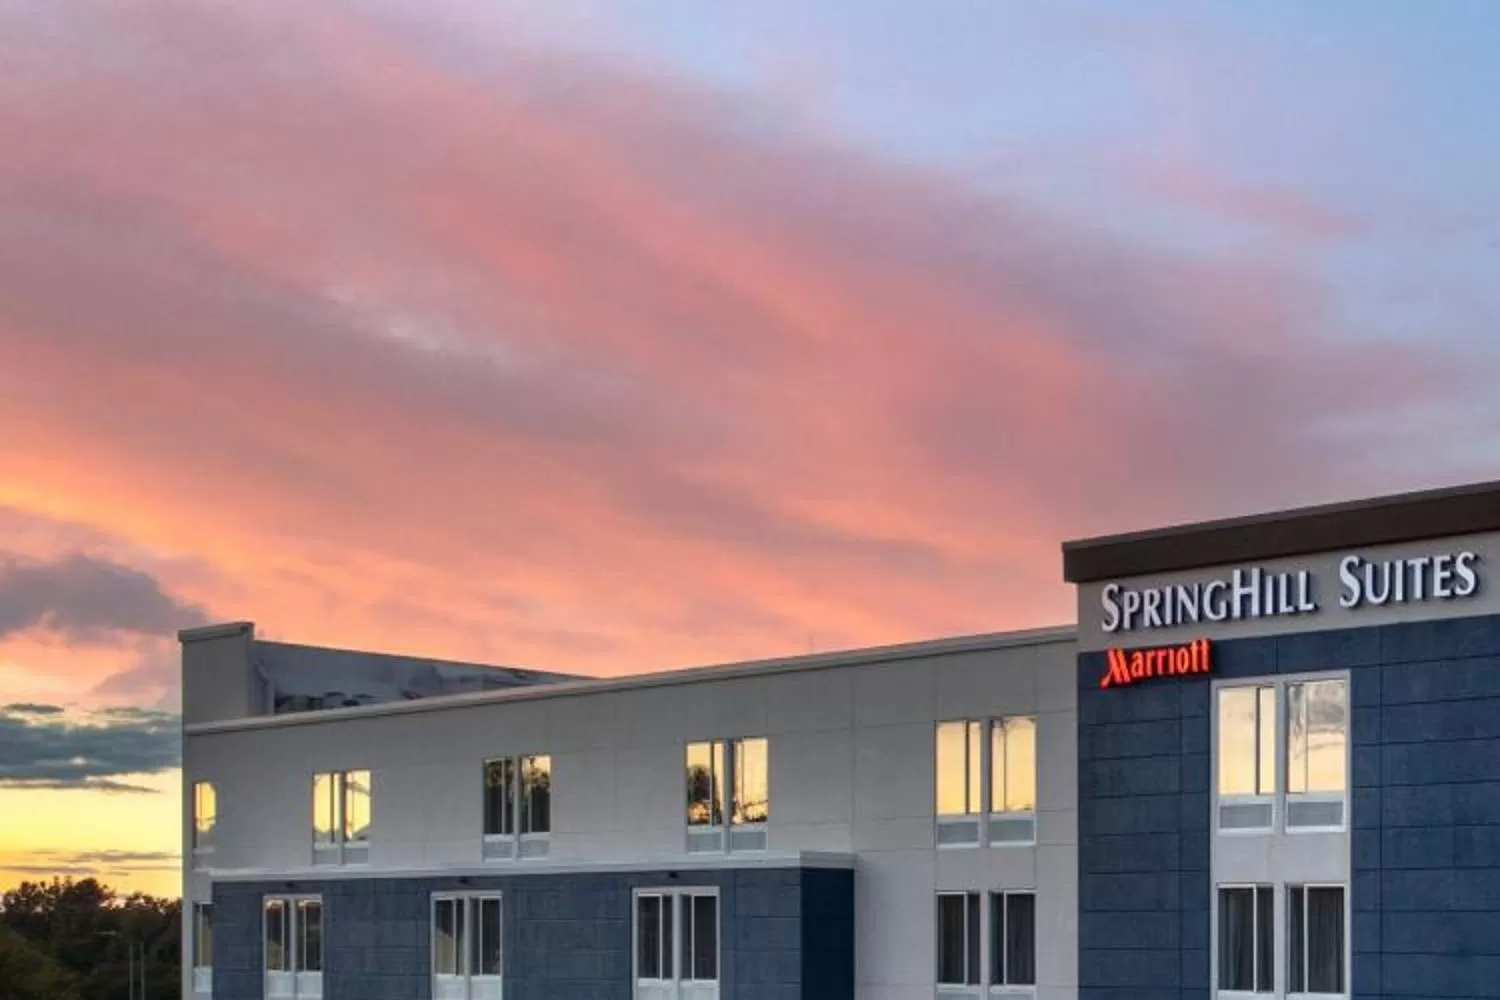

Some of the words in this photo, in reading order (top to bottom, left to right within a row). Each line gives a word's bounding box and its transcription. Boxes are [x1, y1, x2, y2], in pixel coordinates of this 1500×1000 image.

[1101, 566, 1317, 633] SPRINGHILL
[1339, 551, 1480, 609] SUITES
[1100, 638, 1211, 689] Marriott
